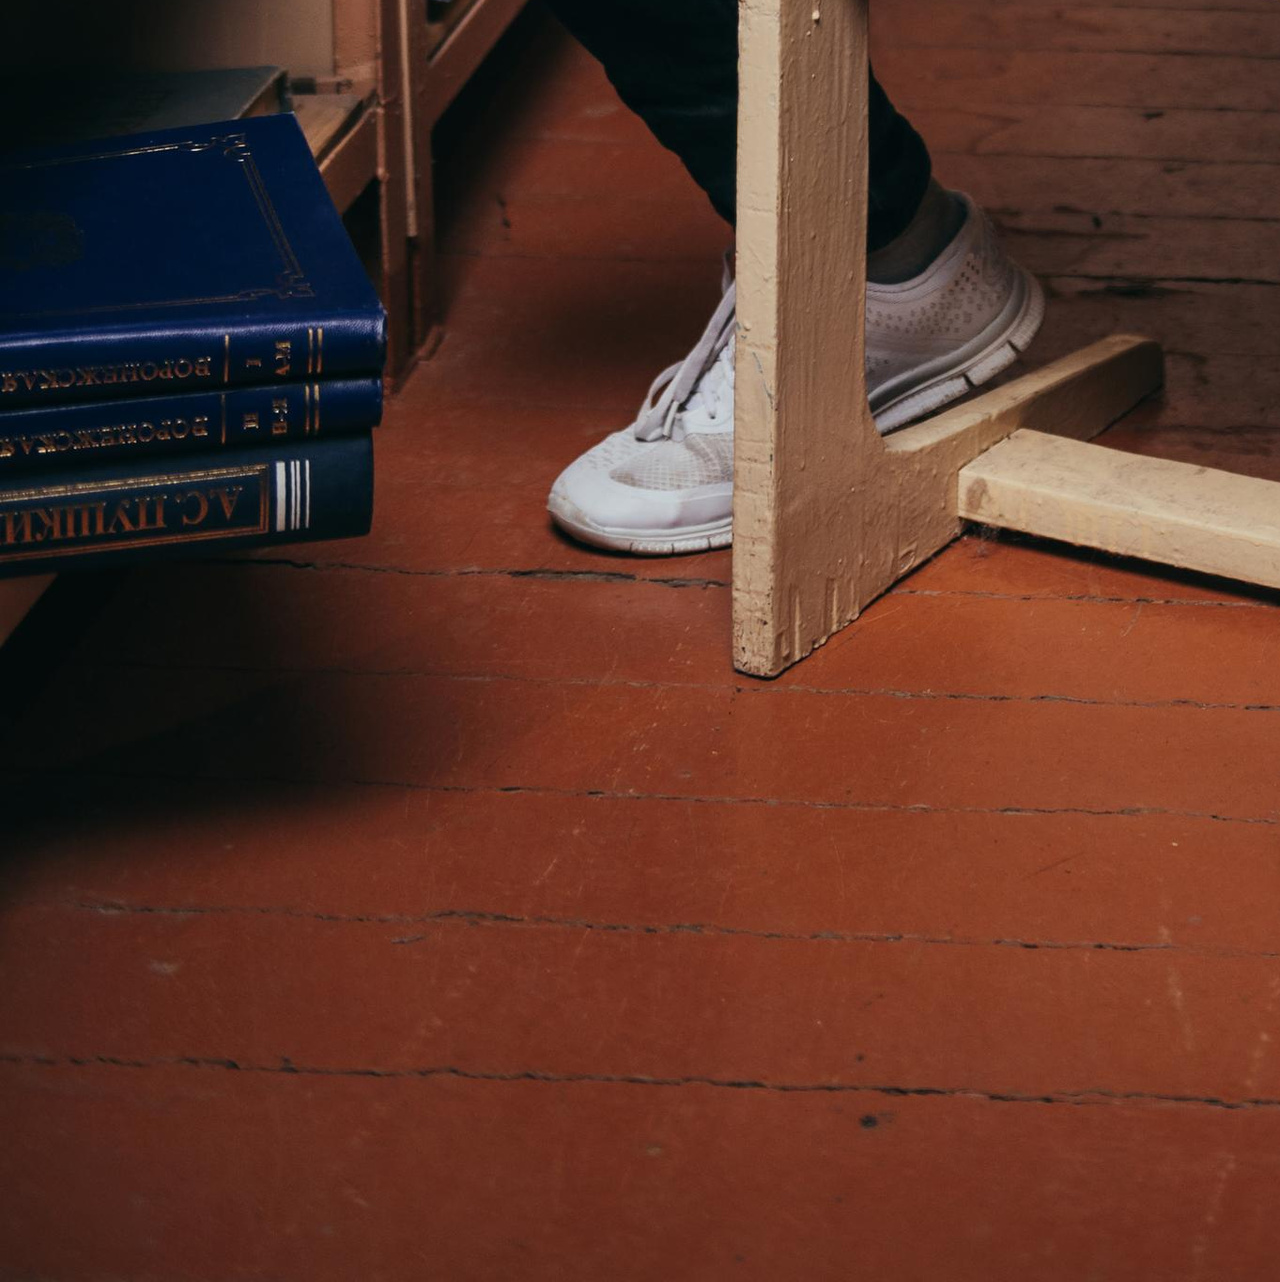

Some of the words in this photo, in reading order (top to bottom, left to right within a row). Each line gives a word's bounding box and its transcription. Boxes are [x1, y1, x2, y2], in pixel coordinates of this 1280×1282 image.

[0, 355, 211, 393] ВОРОНЕЖСКАЯ
[0, 415, 208, 458] ВОРОНЕЖСКАЯ
[0, 494, 168, 545] ПУШКИ
[176, 485, 243, 526] А.С.
